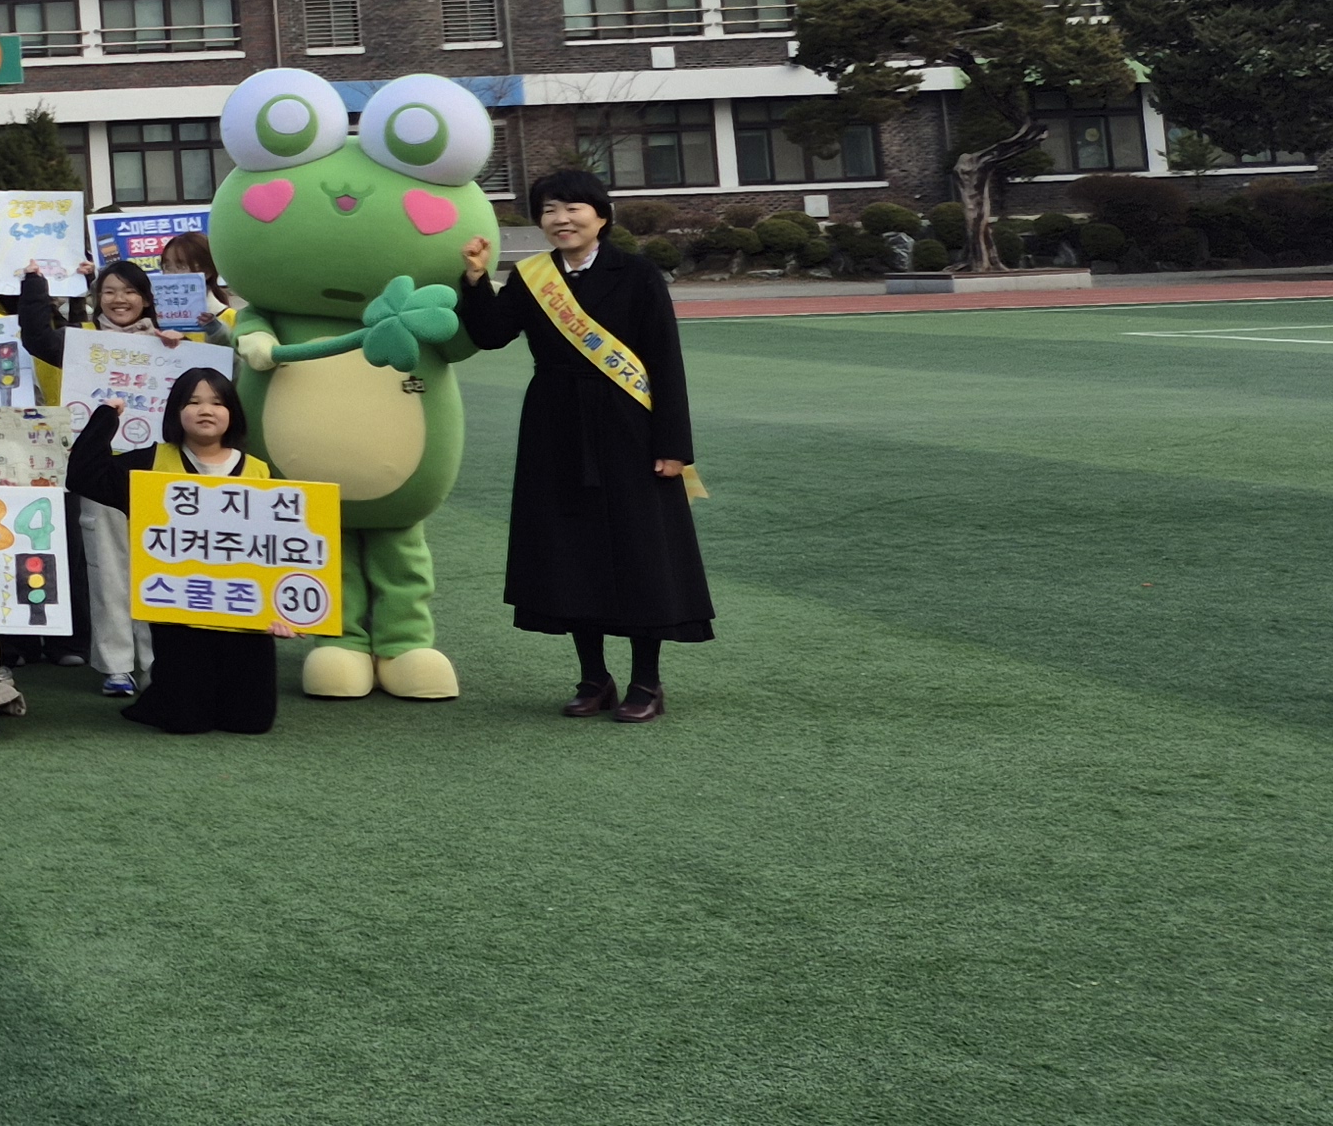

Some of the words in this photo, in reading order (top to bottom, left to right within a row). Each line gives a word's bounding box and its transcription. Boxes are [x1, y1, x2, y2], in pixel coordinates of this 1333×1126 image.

[117, 218, 171, 236] 스마트폰
[174, 216, 202, 232] 대신
[130, 237, 159, 254] 좌우
[148, 527, 324, 566] 지켜주세요!
[144, 577, 257, 613] 스쿨존
[282, 585, 321, 613] 30
